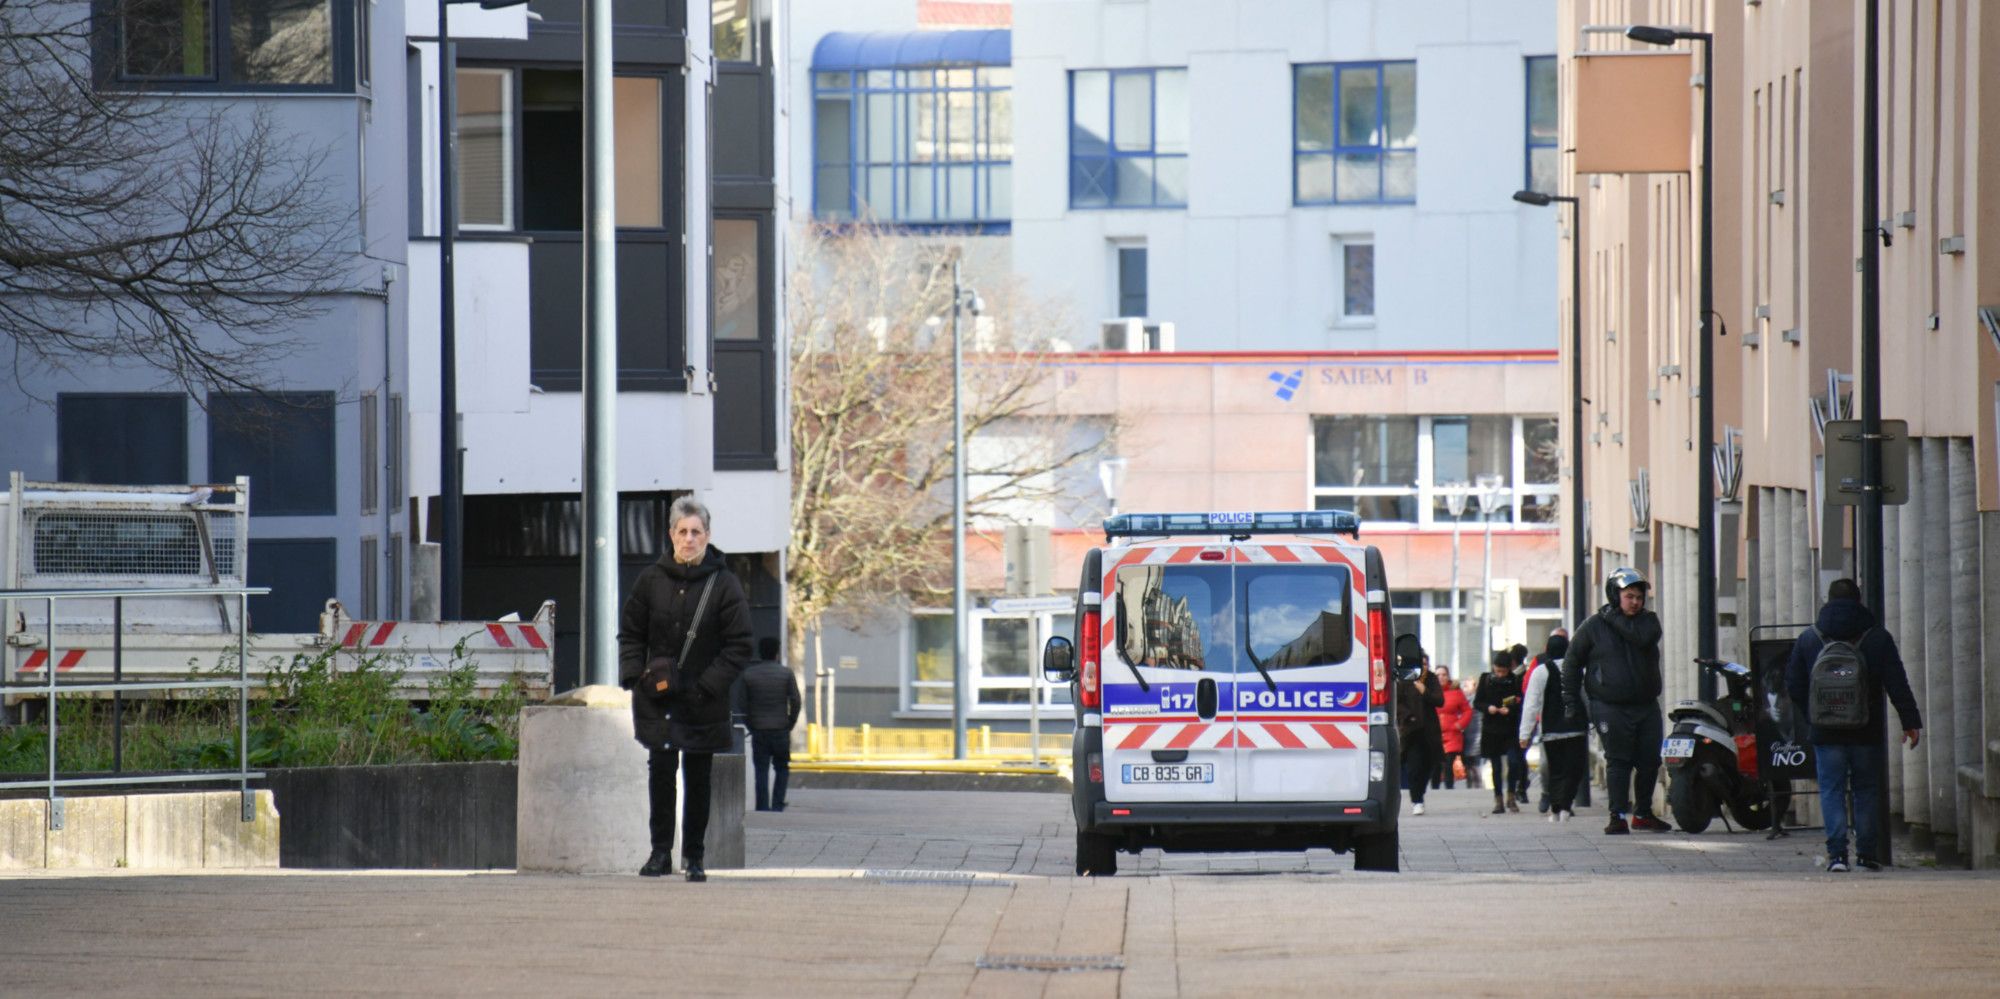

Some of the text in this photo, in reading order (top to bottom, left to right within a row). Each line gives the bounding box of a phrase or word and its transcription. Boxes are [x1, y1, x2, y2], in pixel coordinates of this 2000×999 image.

[1321, 367, 1429, 385] SAIEM B
[1210, 512, 1253, 524] POLICE
[1171, 693, 1194, 709] 17
[1239, 690, 1335, 708] POLICE
[1772, 750, 1807, 767] INO
